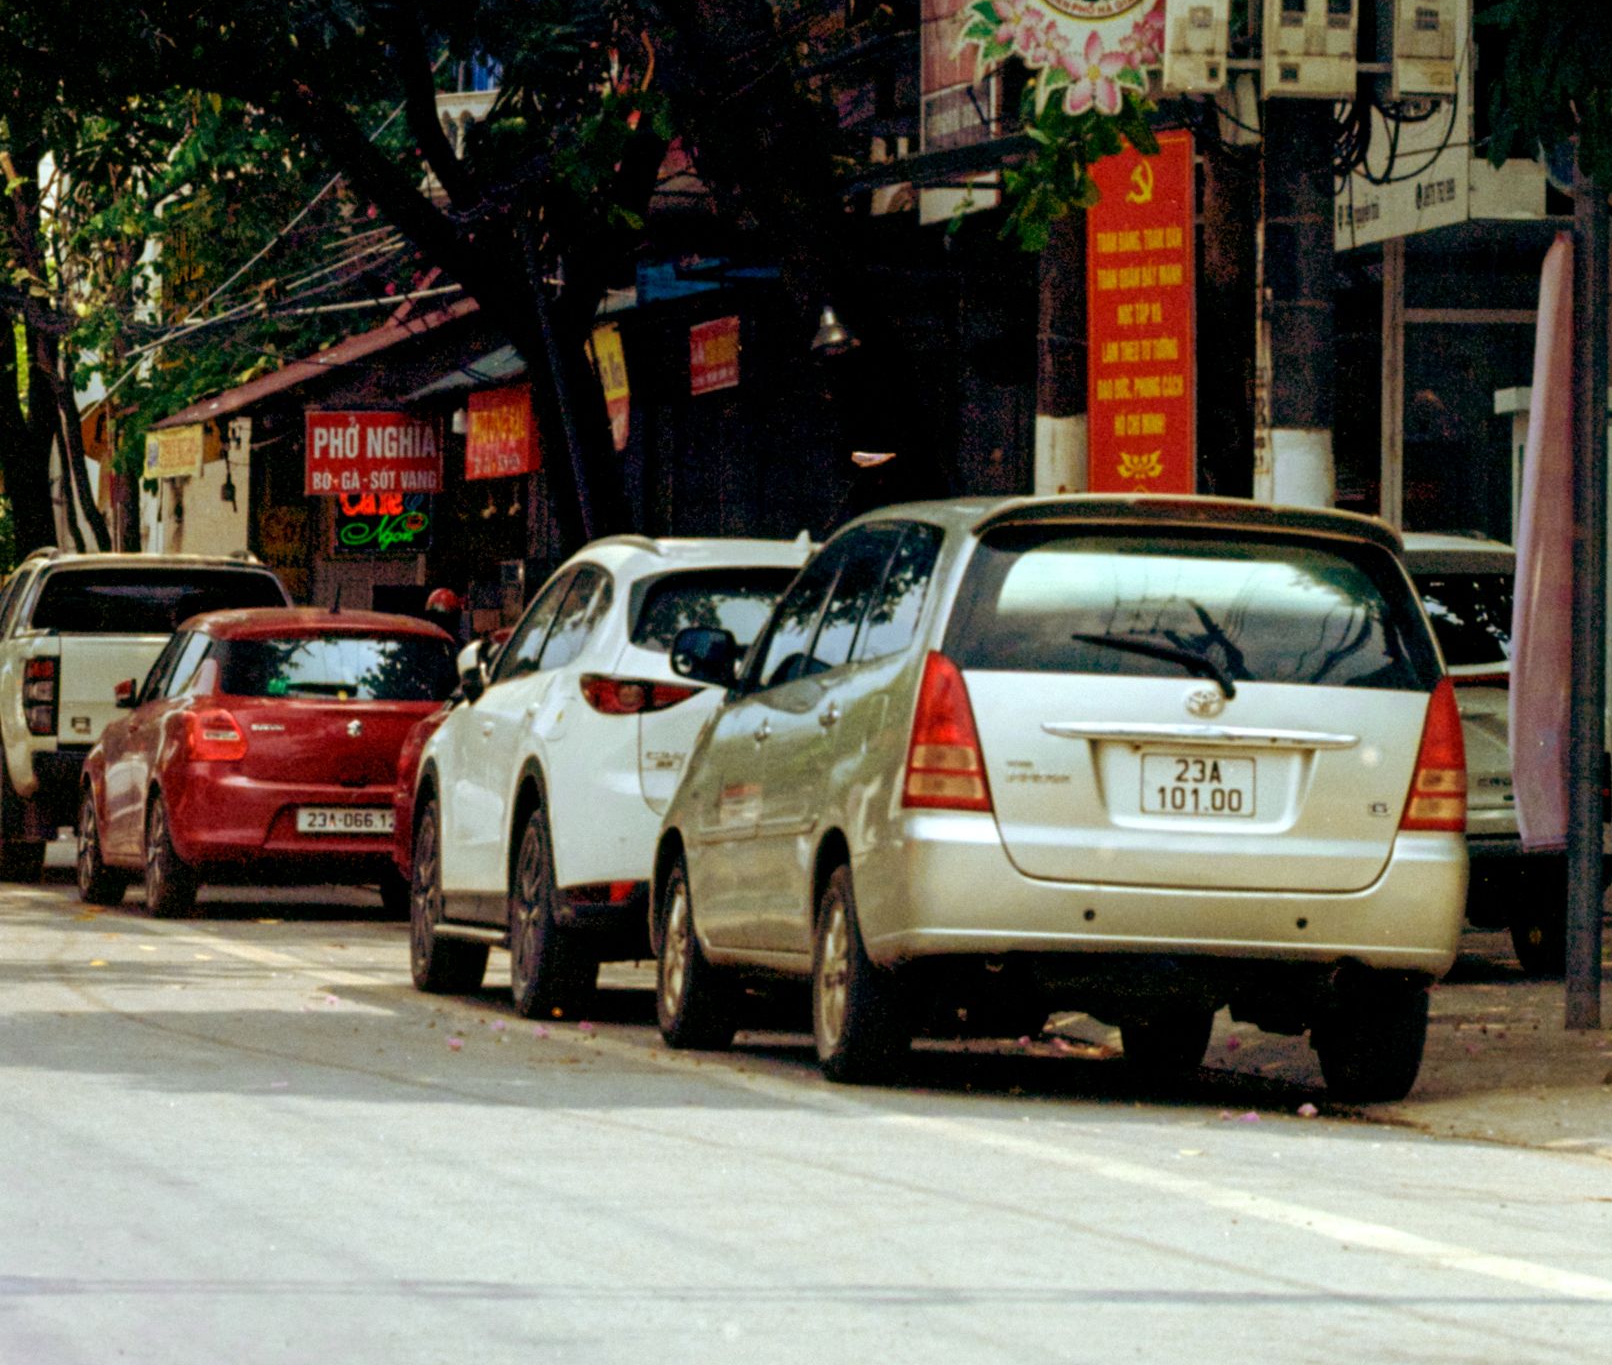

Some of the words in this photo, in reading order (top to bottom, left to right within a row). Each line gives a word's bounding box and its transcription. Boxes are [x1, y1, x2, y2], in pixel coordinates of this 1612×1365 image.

[314, 416, 360, 459] PHỞ
[366, 420, 437, 459] NGHĨA
[1175, 758, 1222, 784] 23A
[1158, 786, 1243, 813] 101.00
